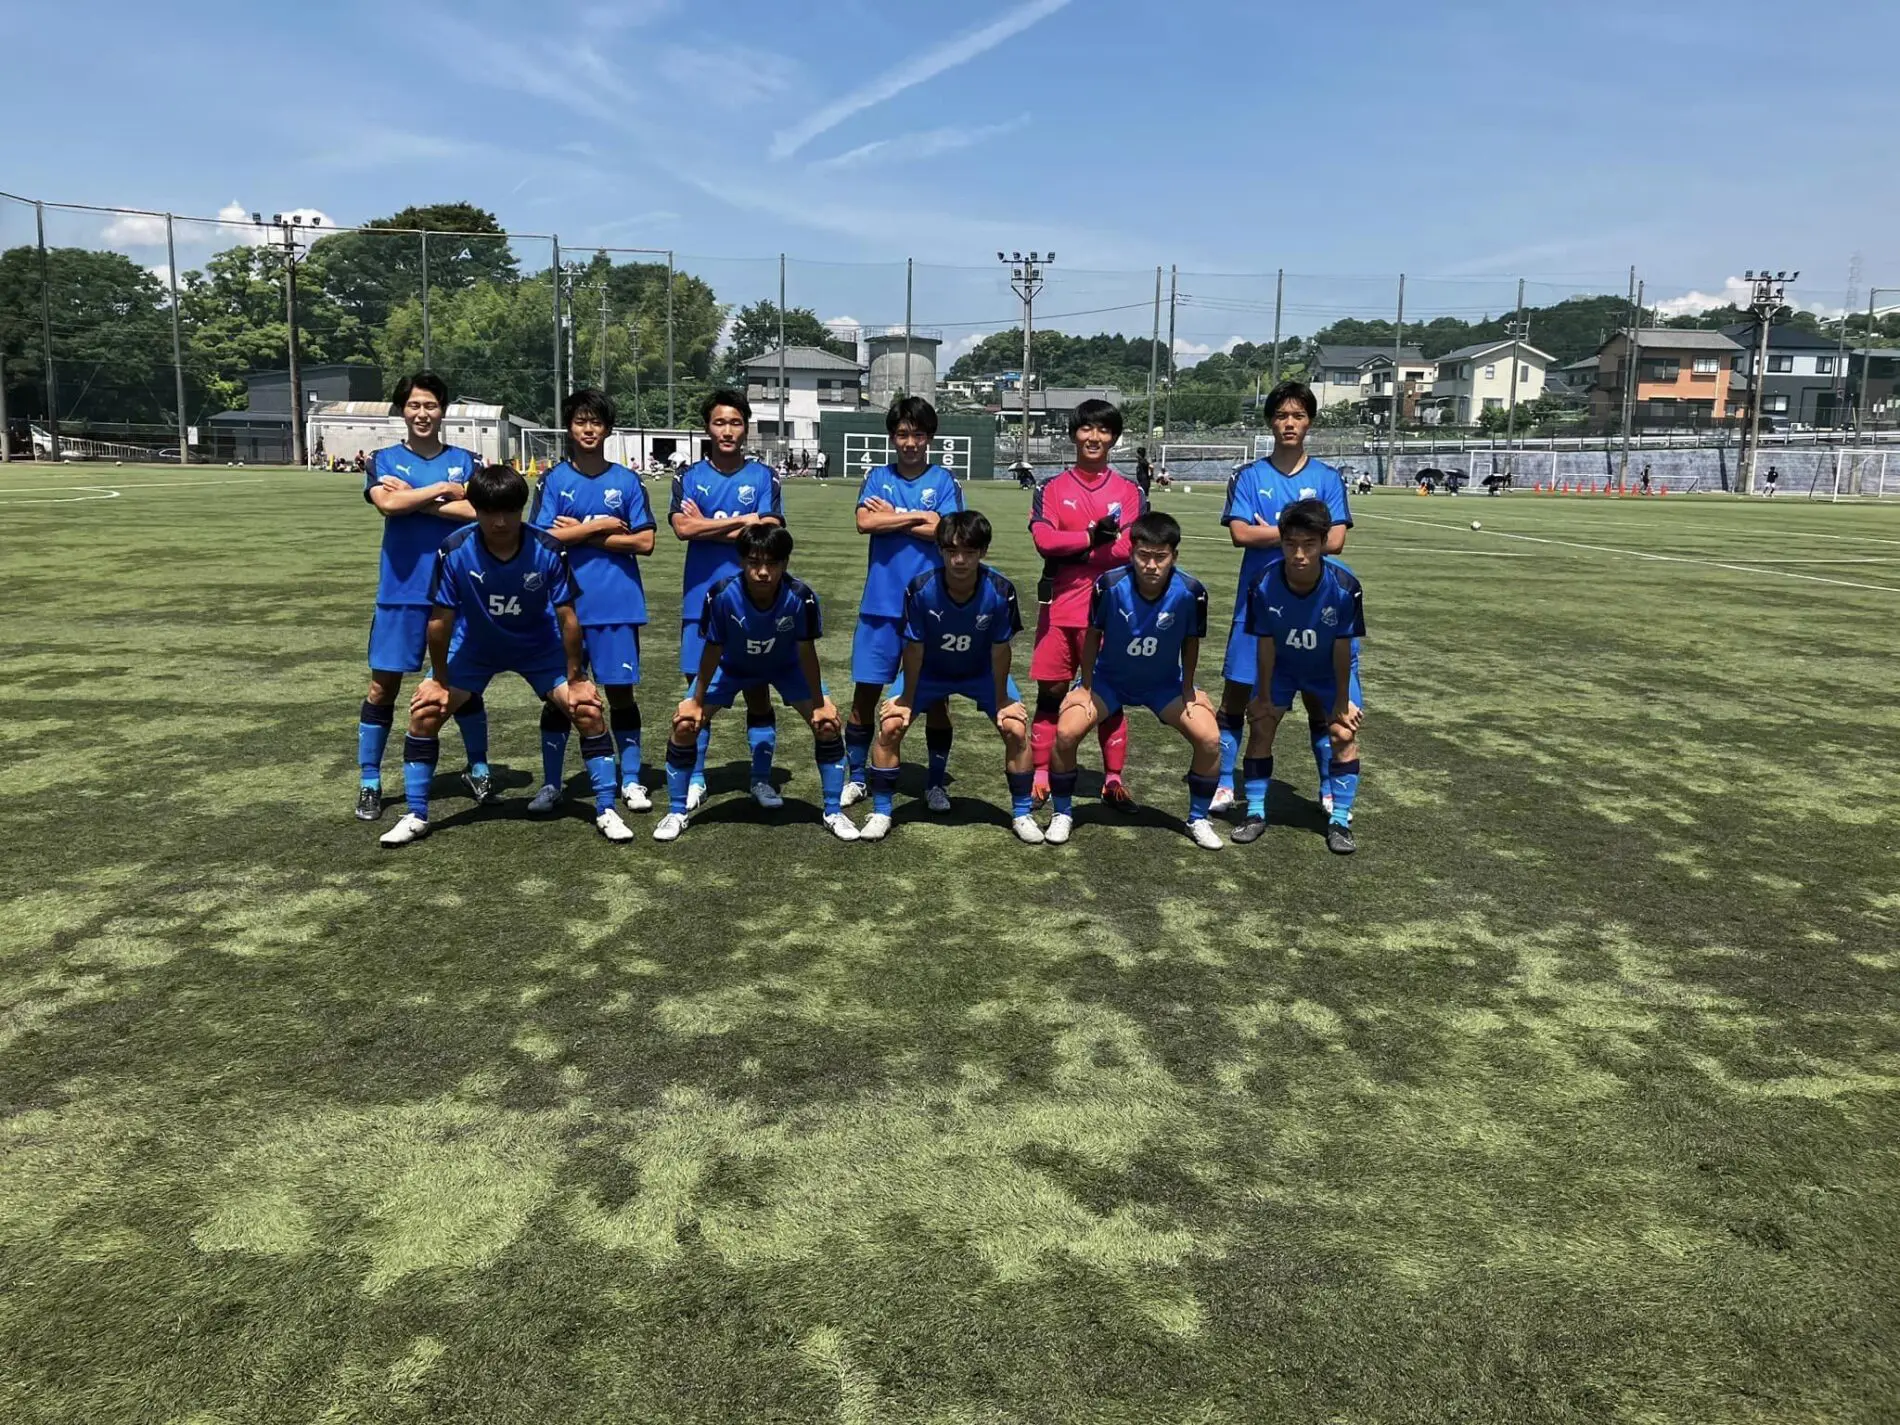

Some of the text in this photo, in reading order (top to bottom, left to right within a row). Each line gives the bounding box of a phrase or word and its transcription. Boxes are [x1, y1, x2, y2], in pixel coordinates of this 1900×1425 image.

[943, 439, 955, 451] 3
[861, 452, 872, 464] 4
[942, 454, 954, 465] 6
[489, 595, 521, 615] 54
[747, 638, 776, 654] 57
[941, 633, 971, 651] 28
[1127, 637, 1157, 656] 68
[1286, 629, 1317, 649] 40
